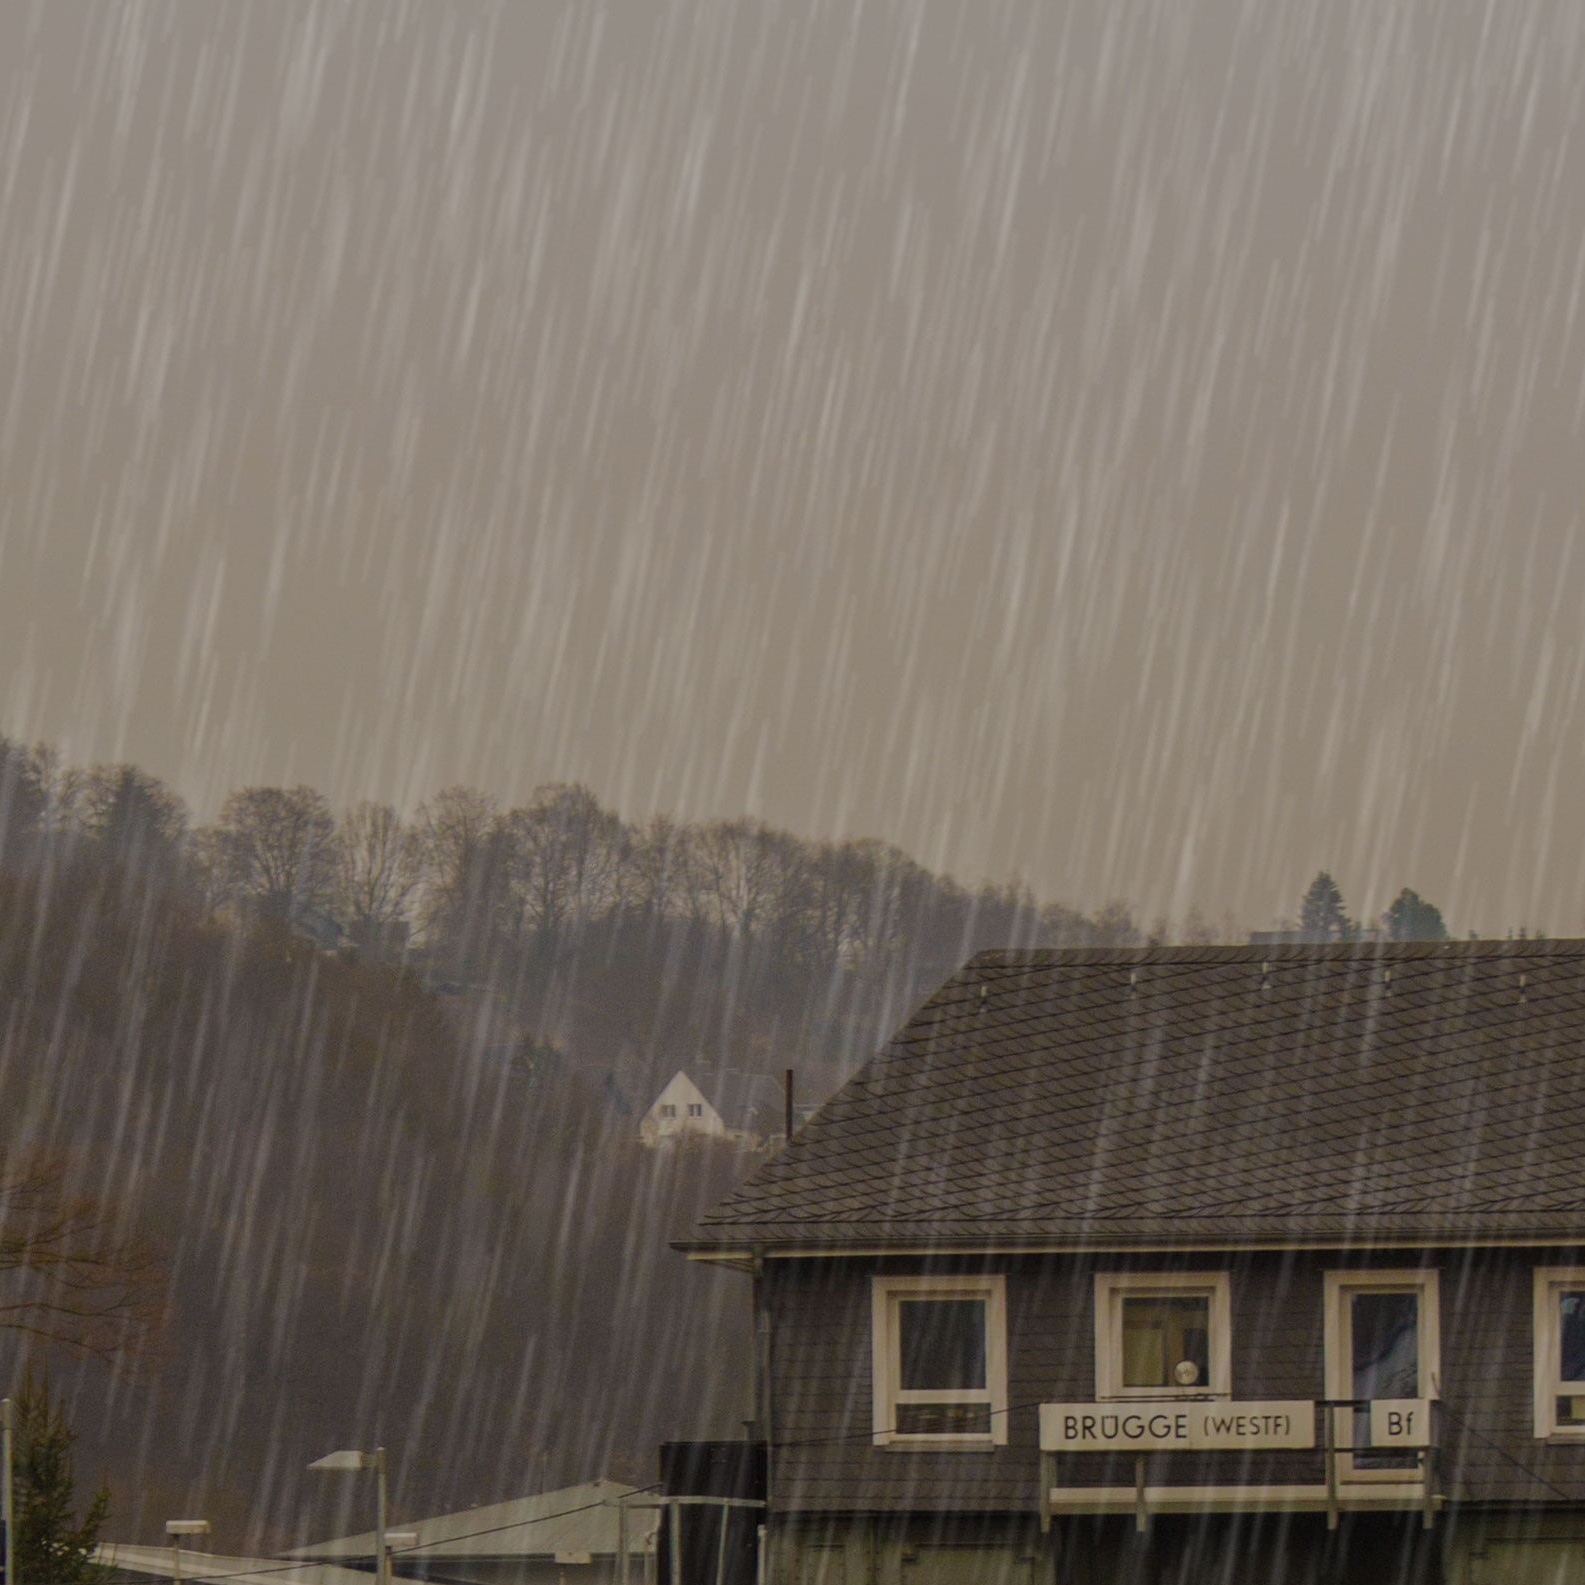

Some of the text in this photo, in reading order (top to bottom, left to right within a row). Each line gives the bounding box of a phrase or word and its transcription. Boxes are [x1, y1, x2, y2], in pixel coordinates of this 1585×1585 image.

[1063, 1413, 1291, 1440] BRÜGGE (WESTF)
[1388, 1412, 1415, 1436] Bf
